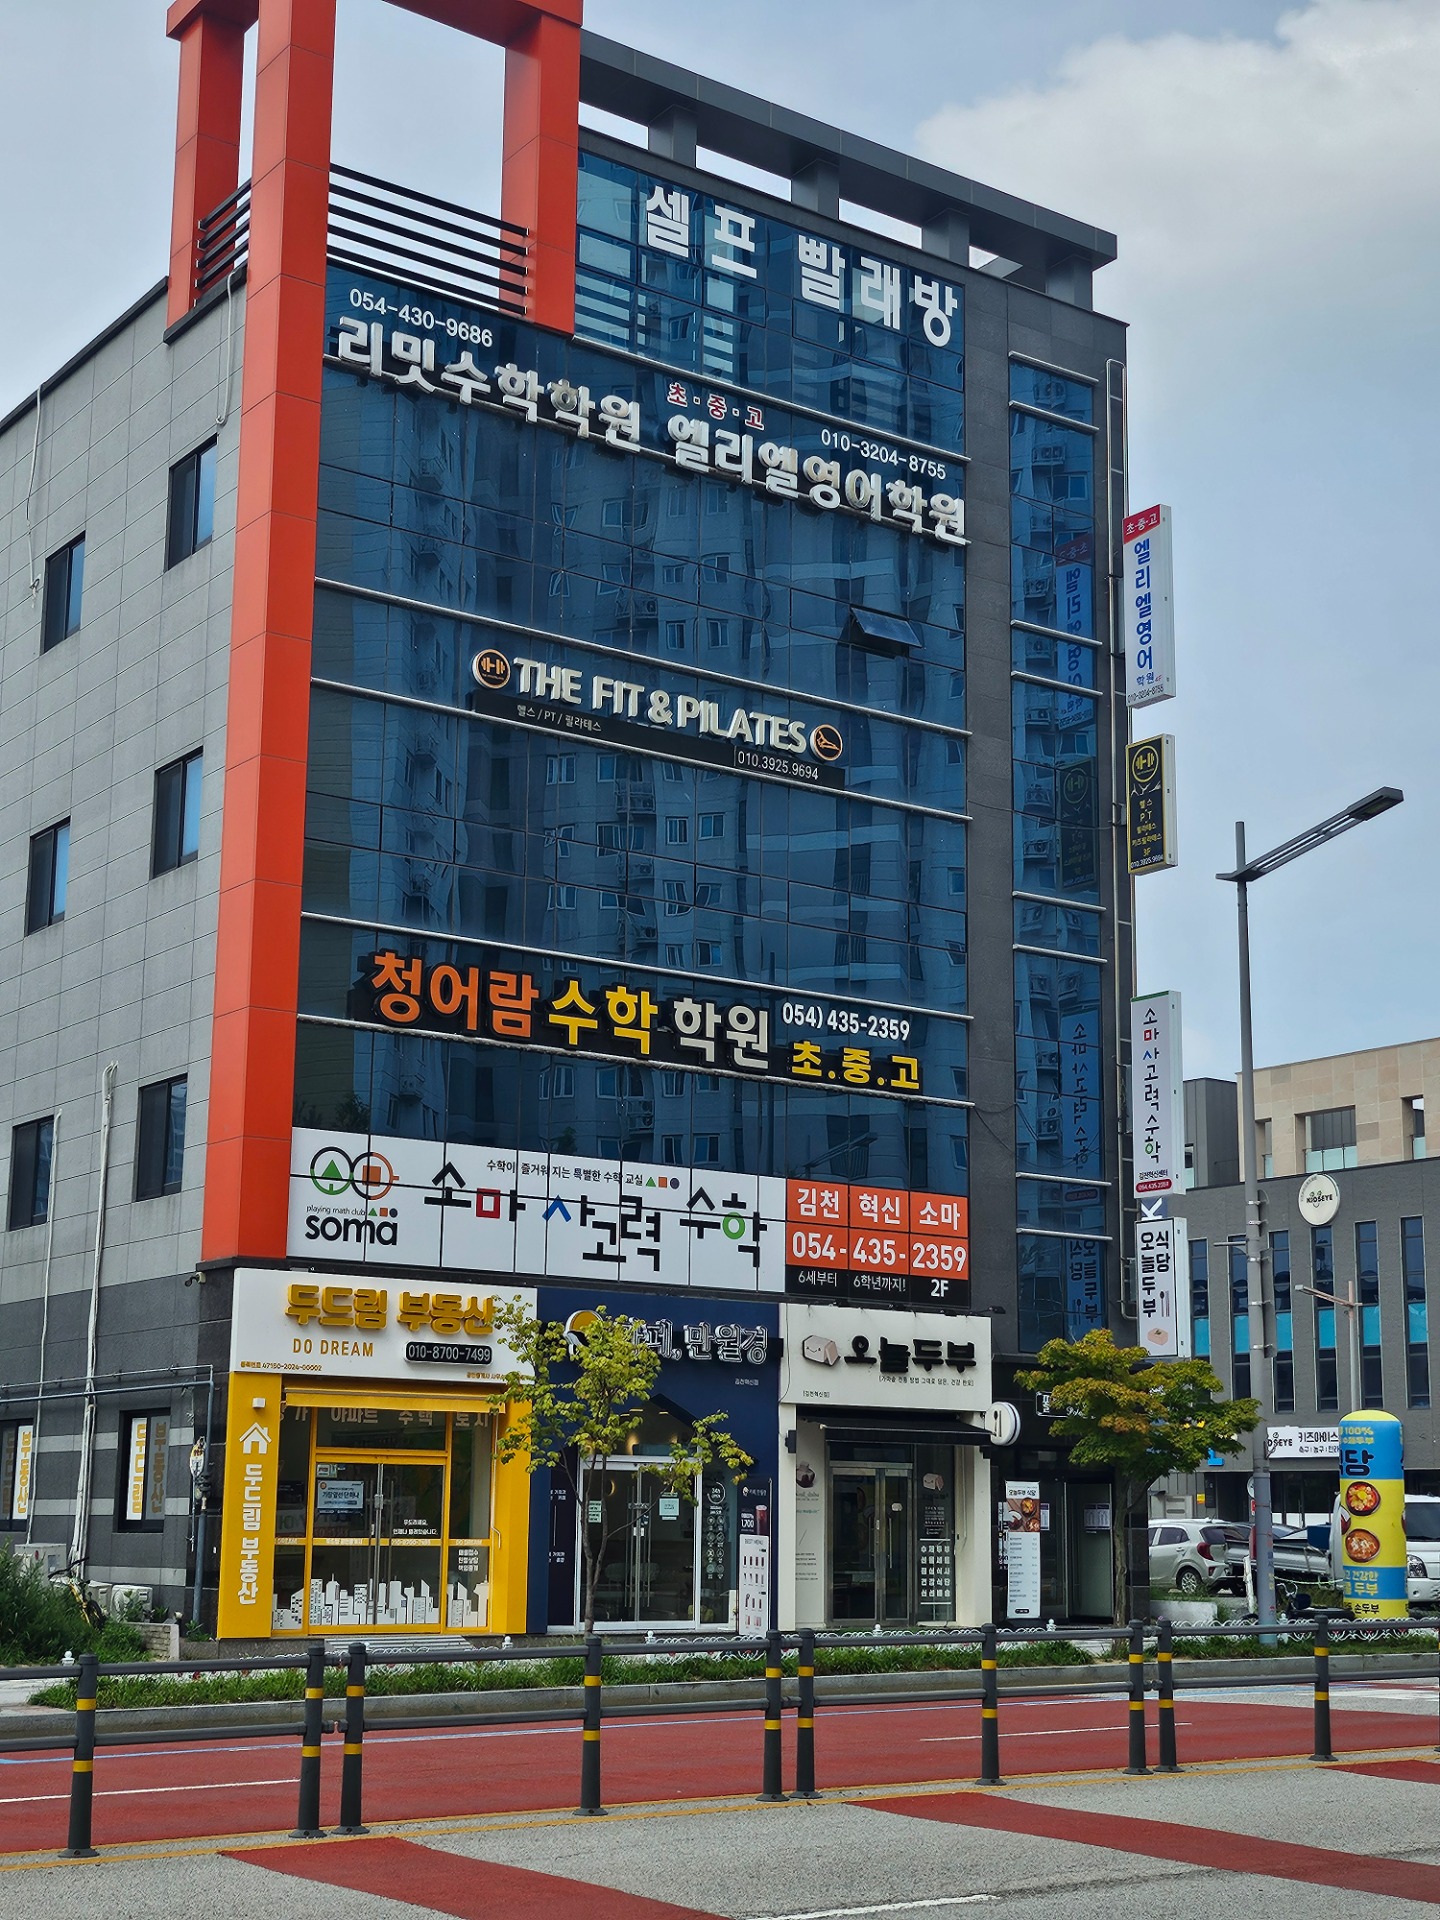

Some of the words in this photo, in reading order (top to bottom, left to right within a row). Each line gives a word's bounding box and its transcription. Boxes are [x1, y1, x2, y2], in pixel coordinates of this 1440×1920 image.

[646, 185, 757, 279] 셀프
[798, 234, 958, 348] 빨래방
[349, 288, 493, 348] 054-430-9686
[821, 429, 947, 480] 010-3204-8755
[1134, 538, 1153, 669] 엘리엘영어
[513, 657, 583, 705] THE
[516, 704, 536, 719] 헬스
[544, 711, 557, 722] PT
[565, 714, 602, 732] 필라테스
[738, 750, 819, 780] 010.3925.9694
[1140, 810, 1152, 822] PT
[371, 952, 539, 1038] 청어람
[549, 980, 659, 1055] 수학
[673, 997, 770, 1069] 학원
[783, 1002, 823, 1028] 054)
[827, 1009, 910, 1041] 435-2359
[486, 1159, 516, 1173] 수학이
[573, 1167, 602, 1182] 특별한
[625, 1174, 643, 1187] 교실
[306, 1204, 331, 1214] playing
[332, 1207, 350, 1215] math
[351, 1208, 366, 1216] club
[796, 1187, 840, 1220] 김천
[858, 1193, 901, 1225] 혁신
[918, 1202, 960, 1230] 소마
[305, 1215, 398, 1246] soma
[798, 1271, 838, 1287] 6세부터
[853, 1274, 906, 1292] 6학년까지!
[930, 1278, 949, 1298] 2F
[1141, 1231, 1156, 1318] 오늘두부
[1156, 1230, 1170, 1273] 식당
[285, 1283, 388, 1330] 두드림
[397, 1291, 495, 1335] 부동산
[293, 1338, 313, 1354] DO
[320, 1339, 374, 1357] DREAM
[408, 1344, 491, 1362] 010-8700-7499
[683, 1321, 769, 1364] 만월경
[844, 1334, 976, 1373] 오늘두부
[331, 1407, 378, 1424] 아파트
[1267, 1438, 1293, 1447] DSEYE
[1298, 1432, 1339, 1443] 키즈아이스
[17, 1431, 31, 1514] 부동산
[152, 1422, 167, 1513] 부동산
[1340, 1449, 1374, 1476] 당
[242, 1464, 262, 1531] 두드림
[237, 1537, 260, 1605] 부동산
